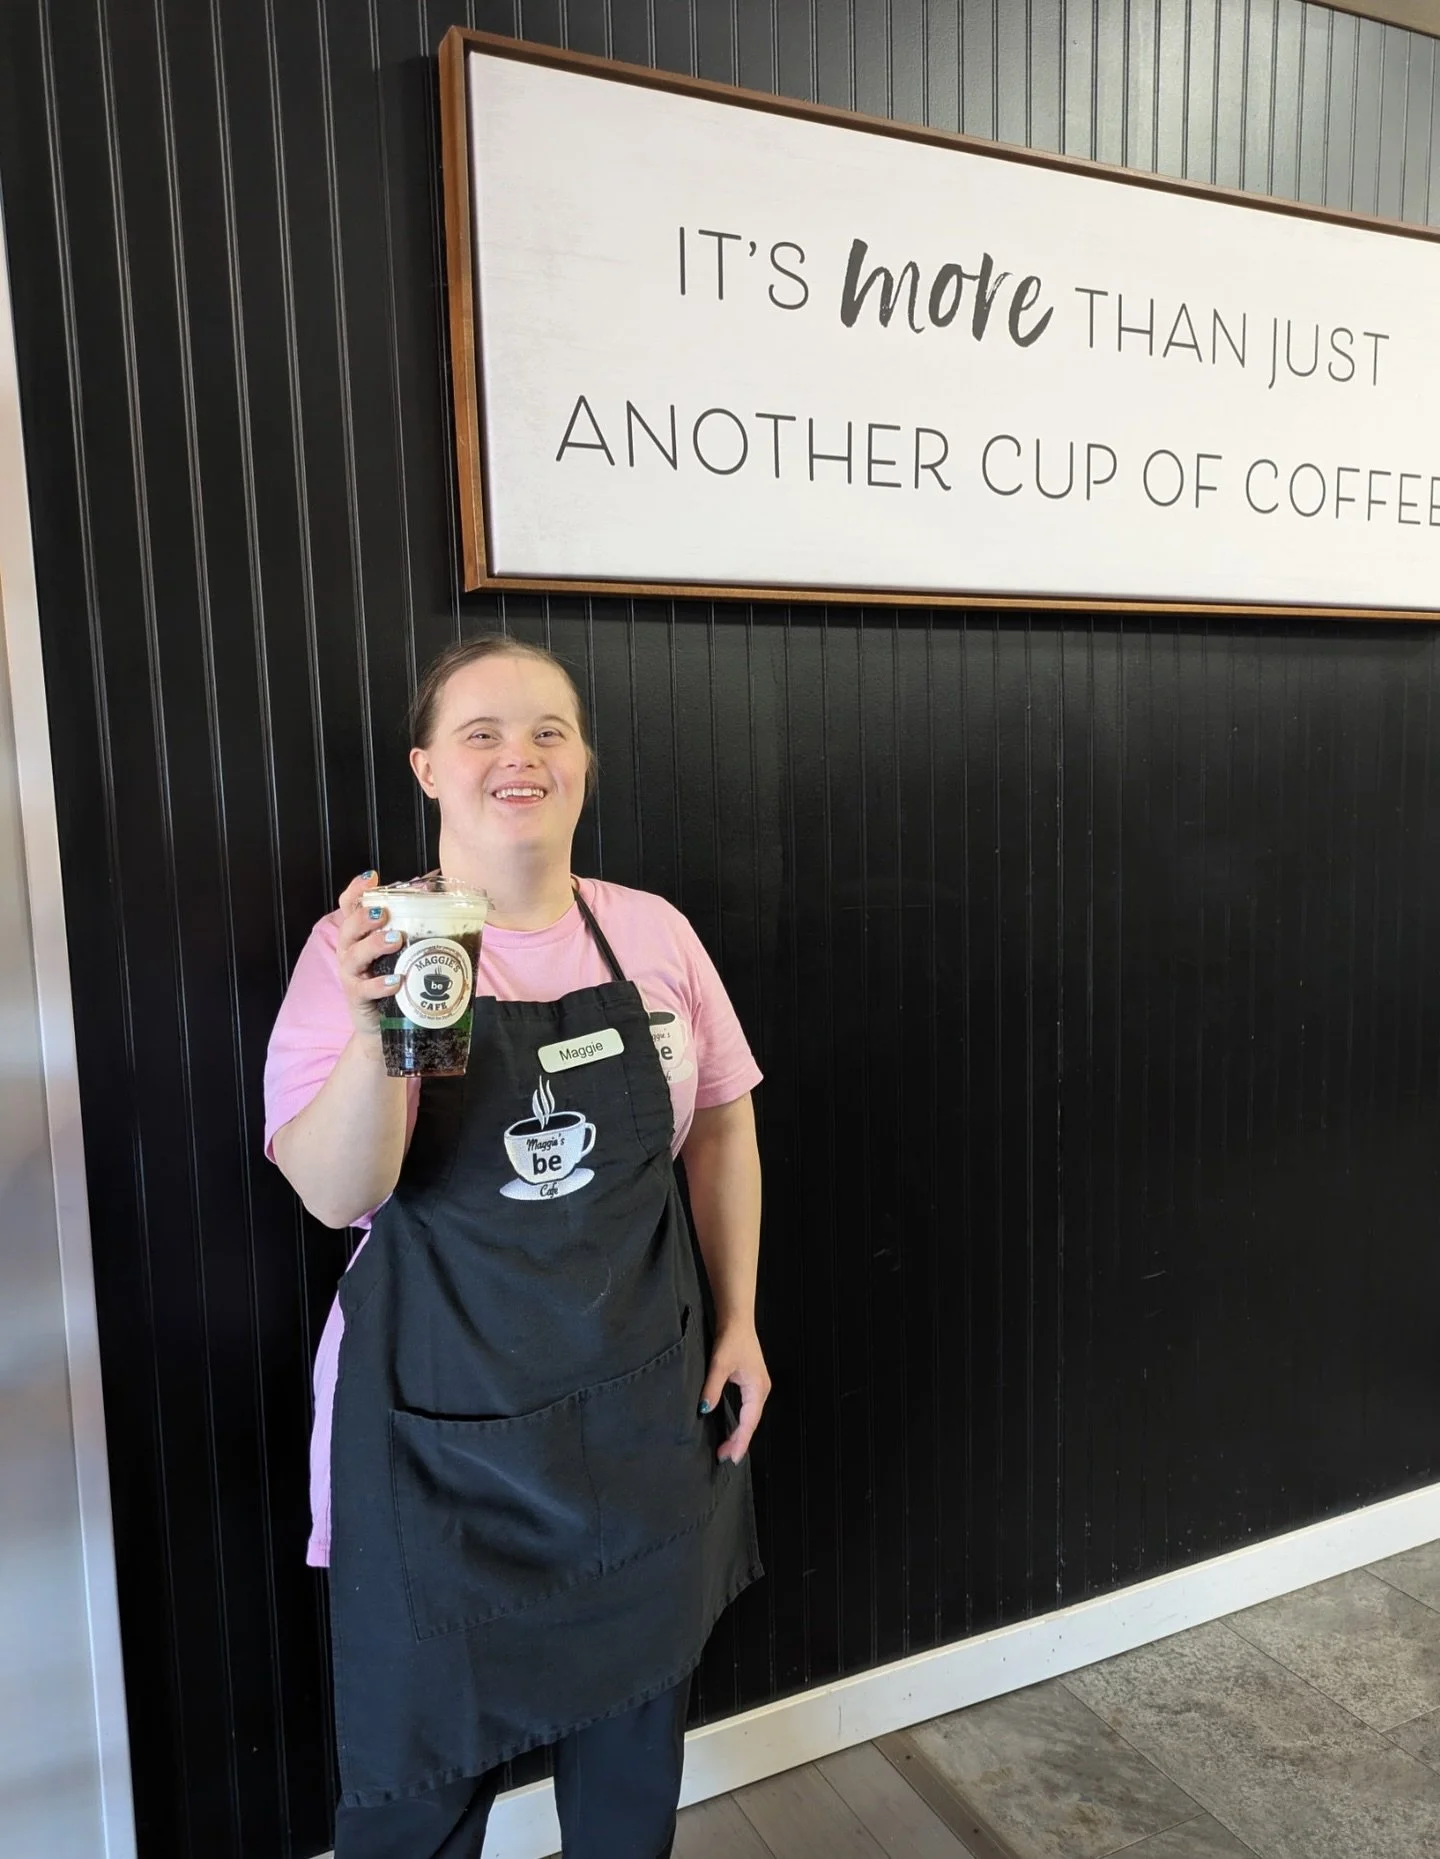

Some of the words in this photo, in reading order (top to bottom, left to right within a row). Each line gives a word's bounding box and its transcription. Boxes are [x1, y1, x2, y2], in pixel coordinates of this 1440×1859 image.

[680, 227, 808, 309] IT'S
[841, 239, 1053, 347] more
[1076, 288, 1245, 366] THAN
[1269, 317, 1389, 388] JUST
[556, 396, 951, 495] ANOTHER
[983, 435, 1116, 500] CUP
[1144, 450, 1221, 507] OF
[415, 956, 461, 973] MAGGIE'S
[431, 981, 443, 990] be
[420, 1000, 448, 1011] CAFE
[559, 1042, 604, 1061] Maggie
[660, 1046, 673, 1060] e
[526, 1133, 565, 1152] Maggie's
[532, 1153, 562, 1175] be
